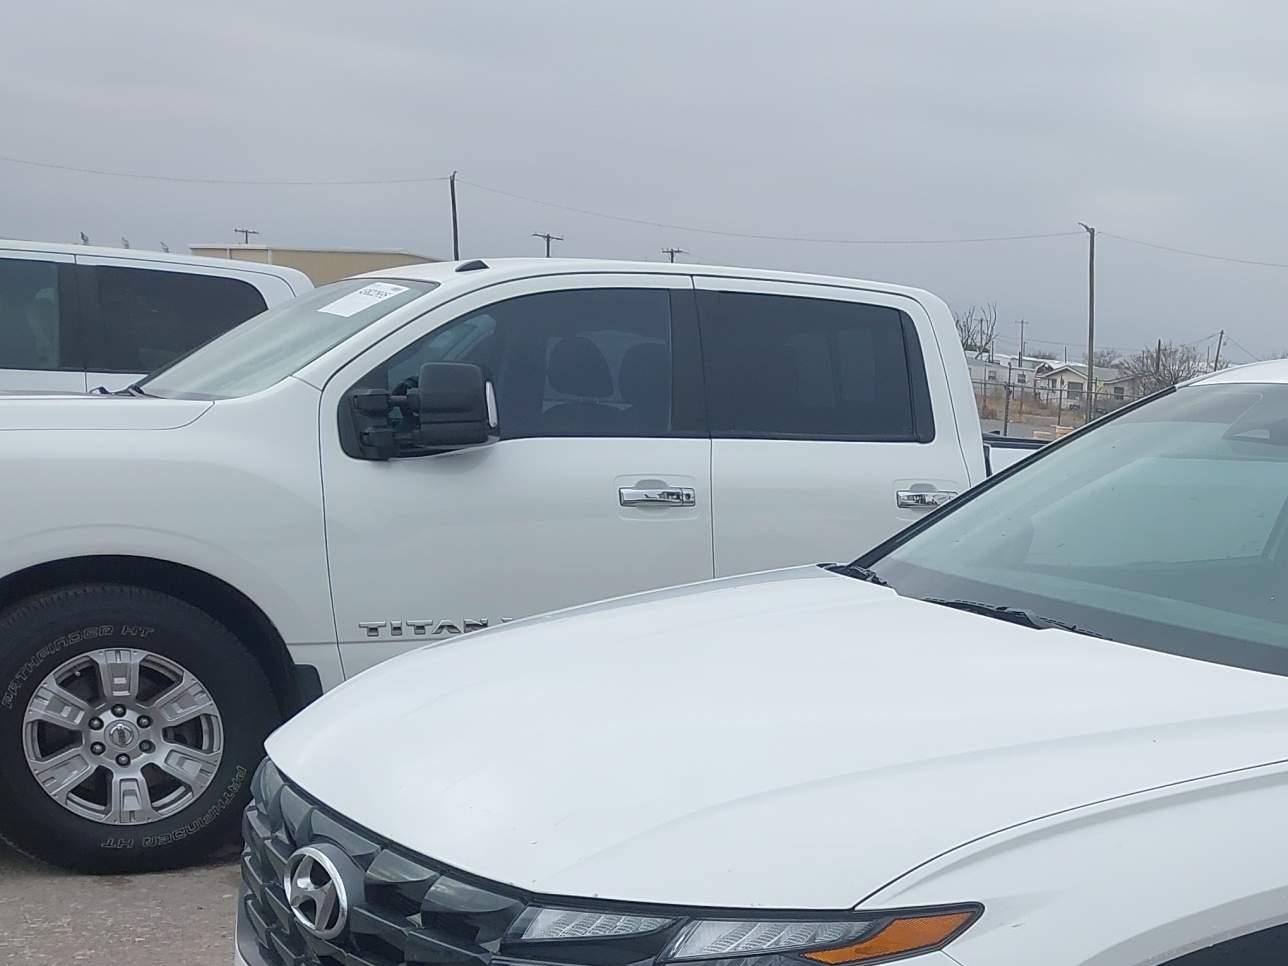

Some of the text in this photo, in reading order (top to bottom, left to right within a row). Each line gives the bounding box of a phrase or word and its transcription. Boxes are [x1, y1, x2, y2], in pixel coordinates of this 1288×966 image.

[358, 618, 489, 638] TITAN
[2, 624, 155, 709] PATHFINDER HT
[101, 837, 134, 849] HT
